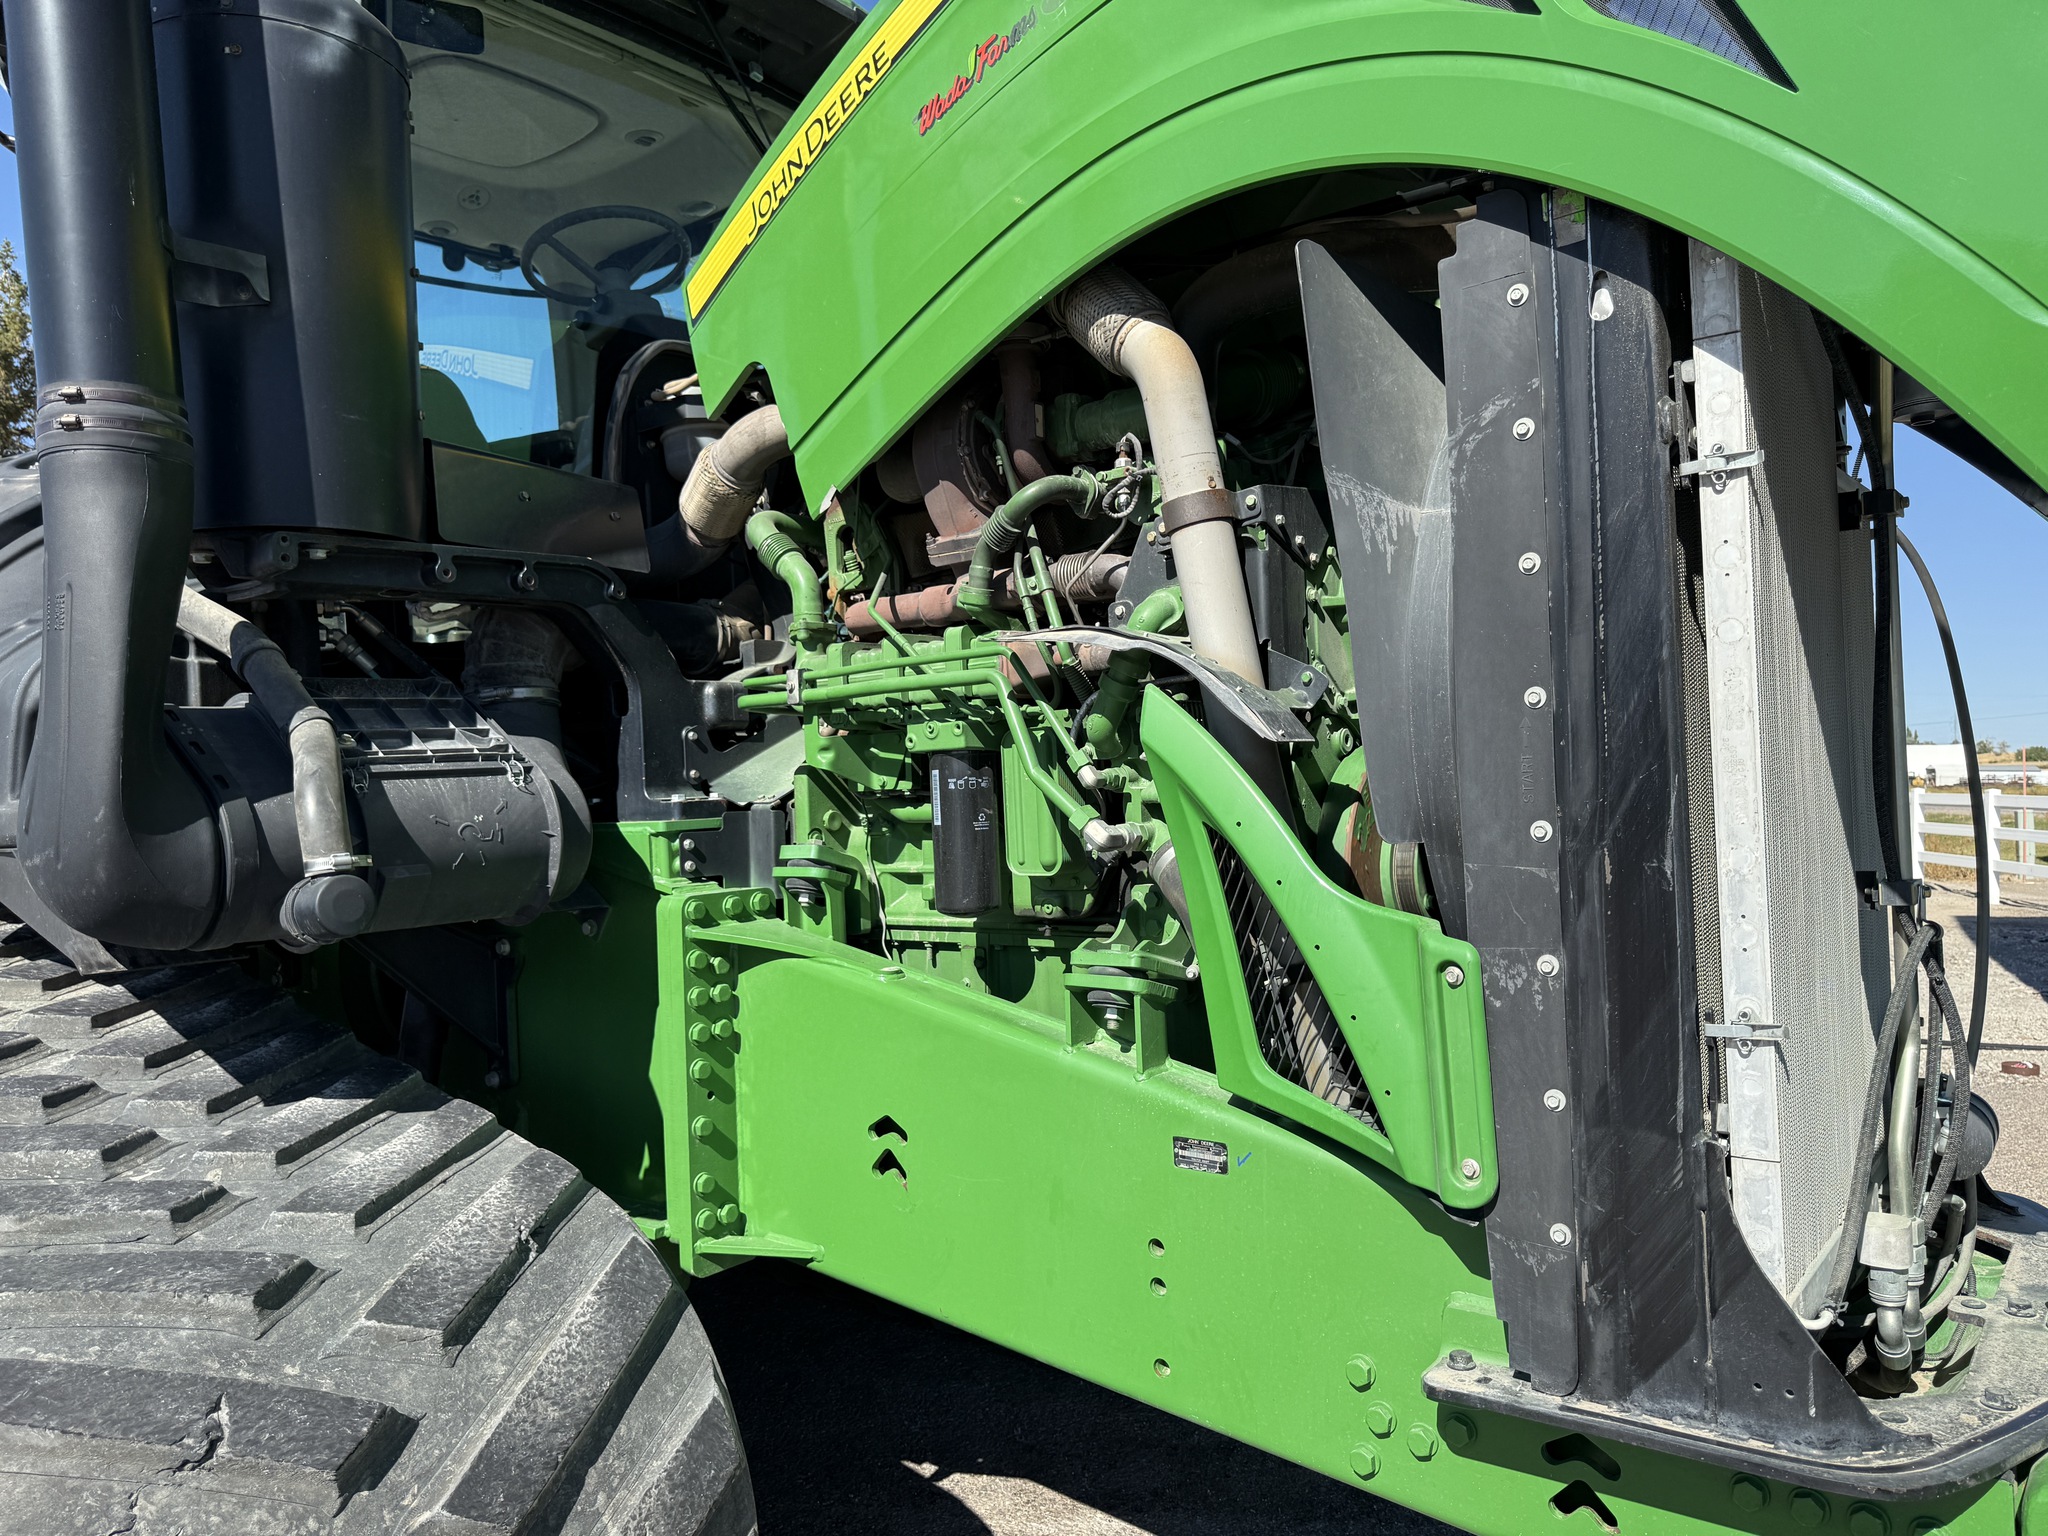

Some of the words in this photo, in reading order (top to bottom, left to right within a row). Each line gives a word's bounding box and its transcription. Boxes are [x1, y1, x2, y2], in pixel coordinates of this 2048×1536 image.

[913, 75, 974, 136] Wada
[748, 147, 804, 237] JOHN
[805, 40, 890, 158] DEERE
[1521, 752, 1534, 803] START
